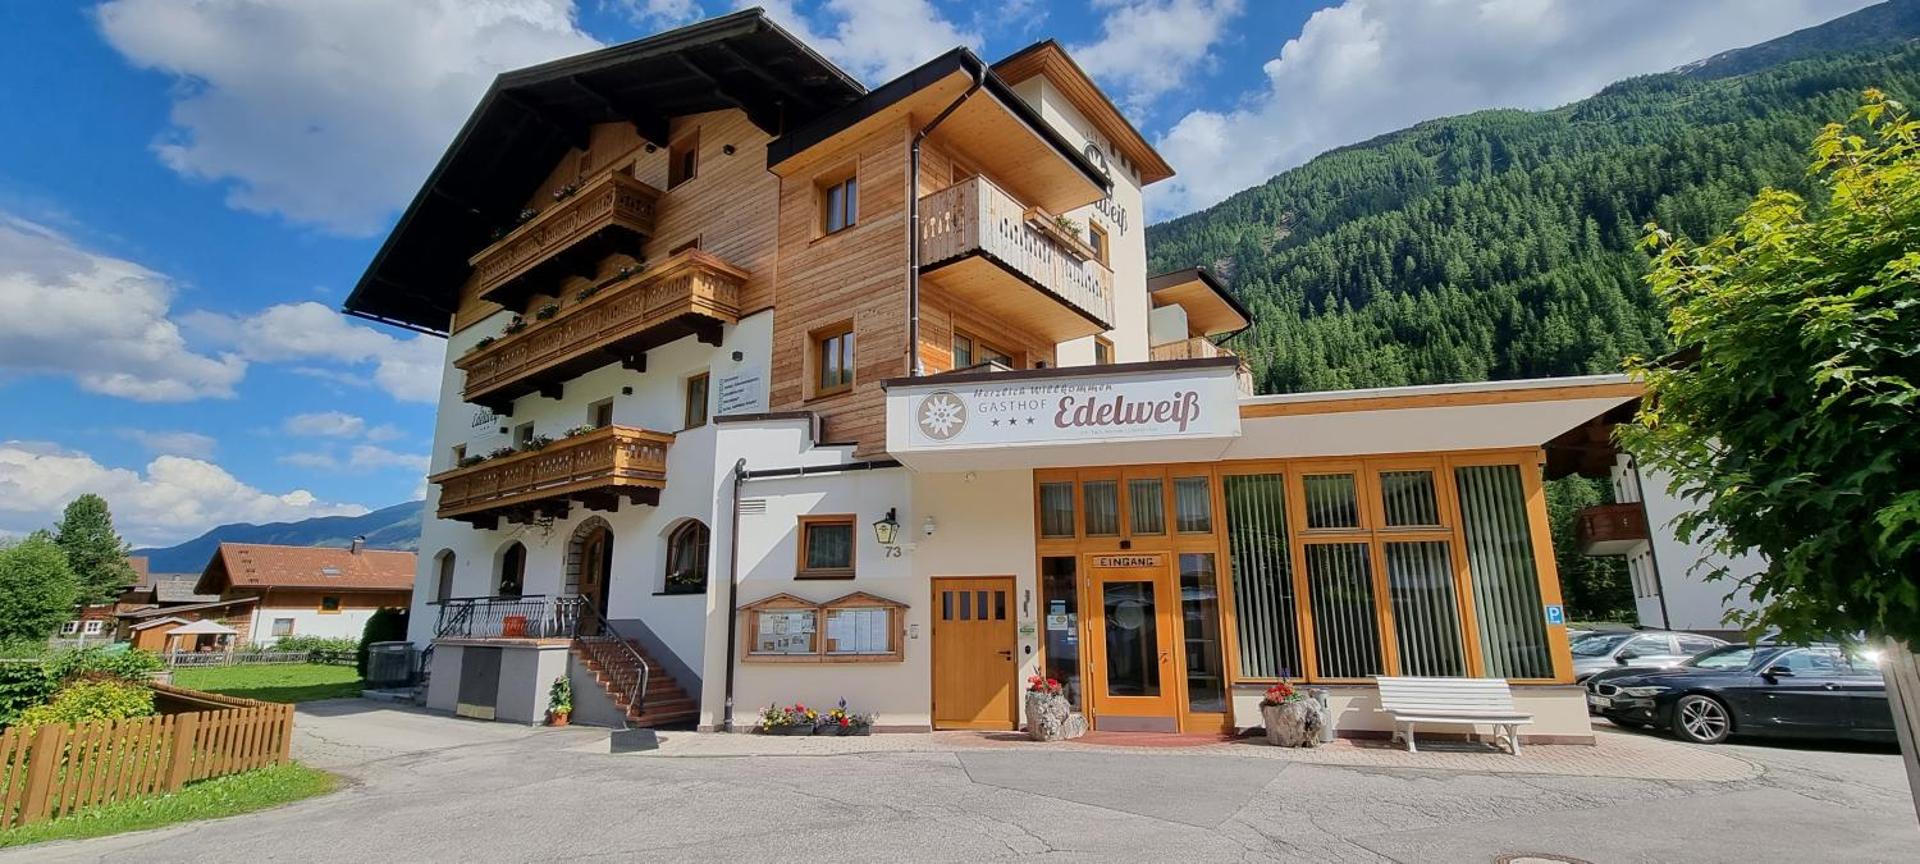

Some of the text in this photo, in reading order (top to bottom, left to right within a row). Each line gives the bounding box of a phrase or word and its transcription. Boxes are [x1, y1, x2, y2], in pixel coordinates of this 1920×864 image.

[974, 383, 1112, 398] Herzlich Willkommen
[978, 399, 1047, 413] GASTHOF
[1054, 391, 1200, 432] Edelweiß
[885, 546, 901, 558] 73
[1100, 557, 1154, 567] EINGANG
[1548, 607, 1560, 622] P
